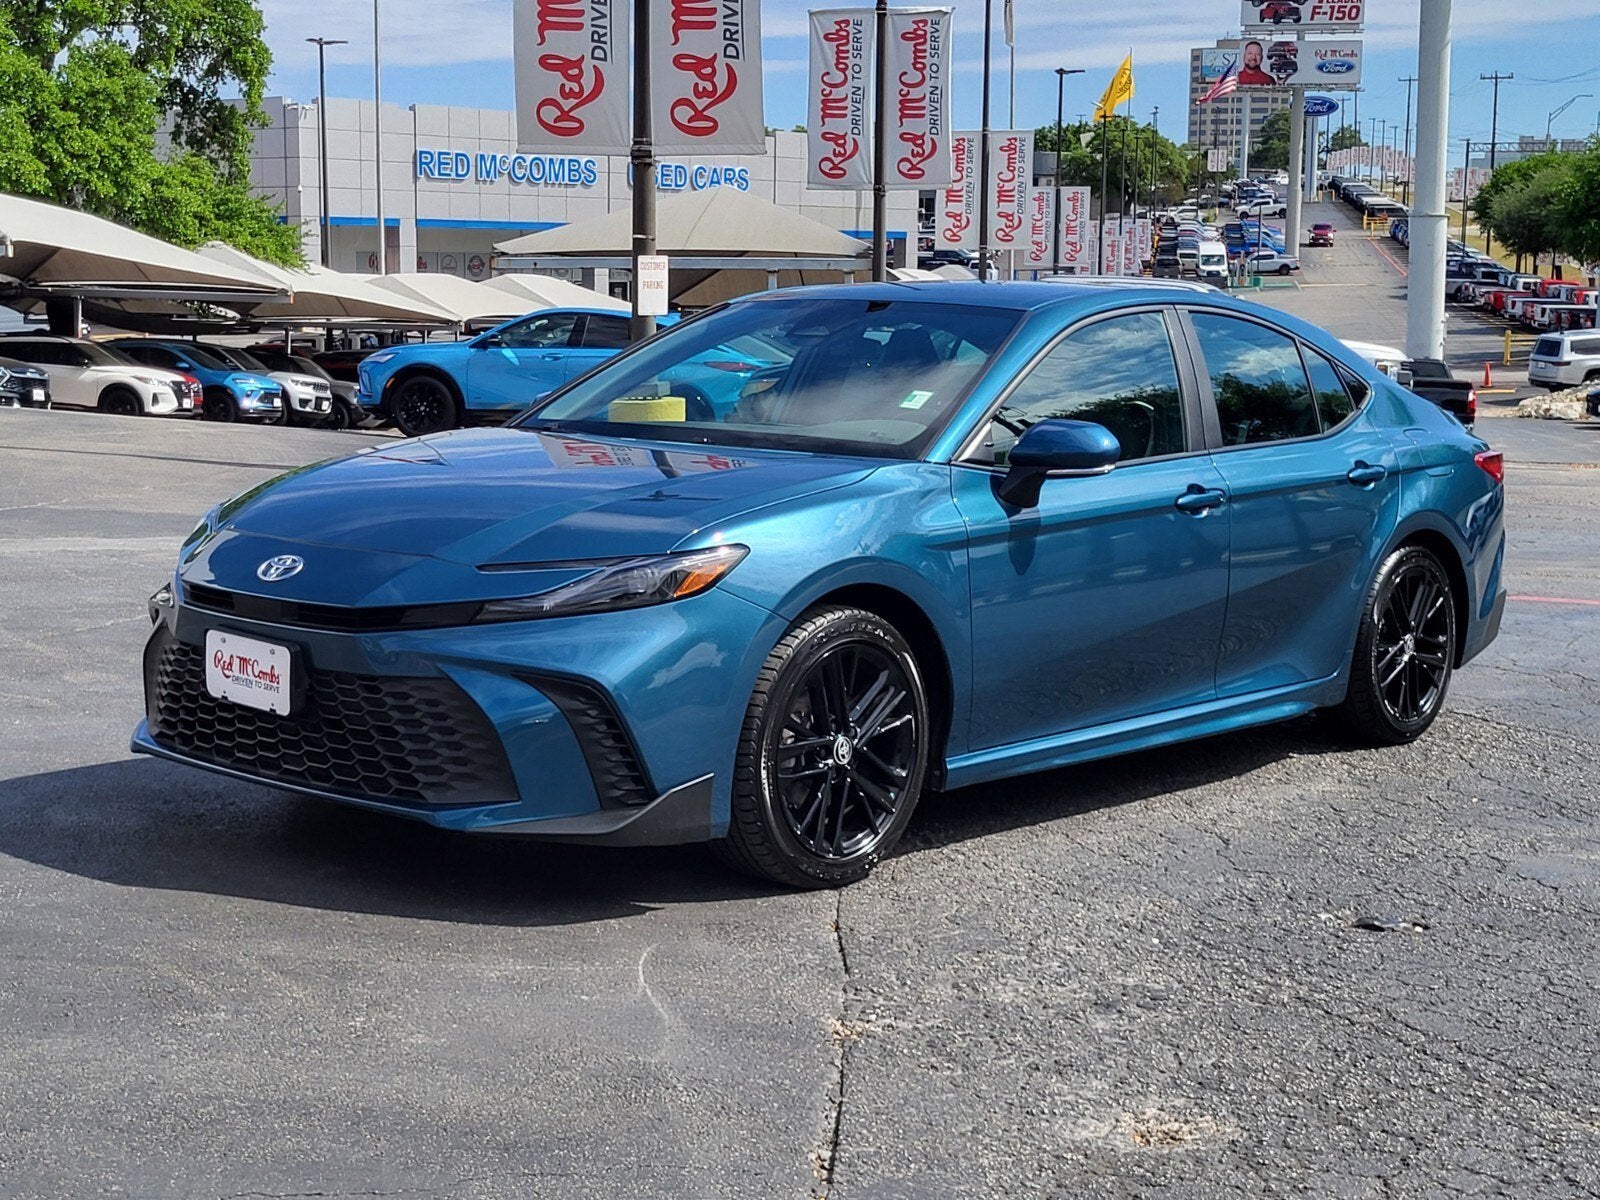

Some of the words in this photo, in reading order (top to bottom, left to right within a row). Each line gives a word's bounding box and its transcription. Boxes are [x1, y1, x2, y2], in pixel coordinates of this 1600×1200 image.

[1310, 5, 1361, 21] F-150
[851, 18, 863, 60] SERVE
[929, 18, 941, 60] SERVE
[820, 18, 851, 127] McCombs
[851, 63, 862, 82] TO
[898, 18, 928, 127] McCombs
[929, 63, 940, 82] TO
[1322, 61, 1348, 72] Ford
[536, 53, 605, 137] Red
[670, 52, 738, 137] Red
[851, 85, 862, 136] DRIVEN
[929, 85, 940, 136] DRIVEN
[417, 150, 471, 179] RED
[818, 131, 859, 179] Red
[897, 131, 937, 179] Red
[966, 137, 974, 164] SERVE
[1018, 137, 1026, 164] SERVE
[694, 165, 749, 191] CARS
[966, 166, 974, 179] TO
[996, 137, 1018, 209] McCombs
[1017, 166, 1025, 180] TO
[965, 181, 973, 215] DRIVEN
[1017, 181, 1025, 215] DRIVEN
[943, 211, 970, 242] Red
[995, 211, 1022, 242] Red
[1031, 191, 1045, 238] McCombs
[1065, 191, 1079, 238] McCombs
[1030, 240, 1048, 261] Red
[1064, 240, 1082, 261] Red
[640, 262, 666, 271] CUSTOMER
[643, 280, 664, 290] PARKING
[214, 649, 234, 679] Red
[236, 655, 280, 685] McCombs
[231, 674, 253, 687] DRIVEN
[254, 680, 263, 689] TO
[263, 682, 280, 694] SERVE
